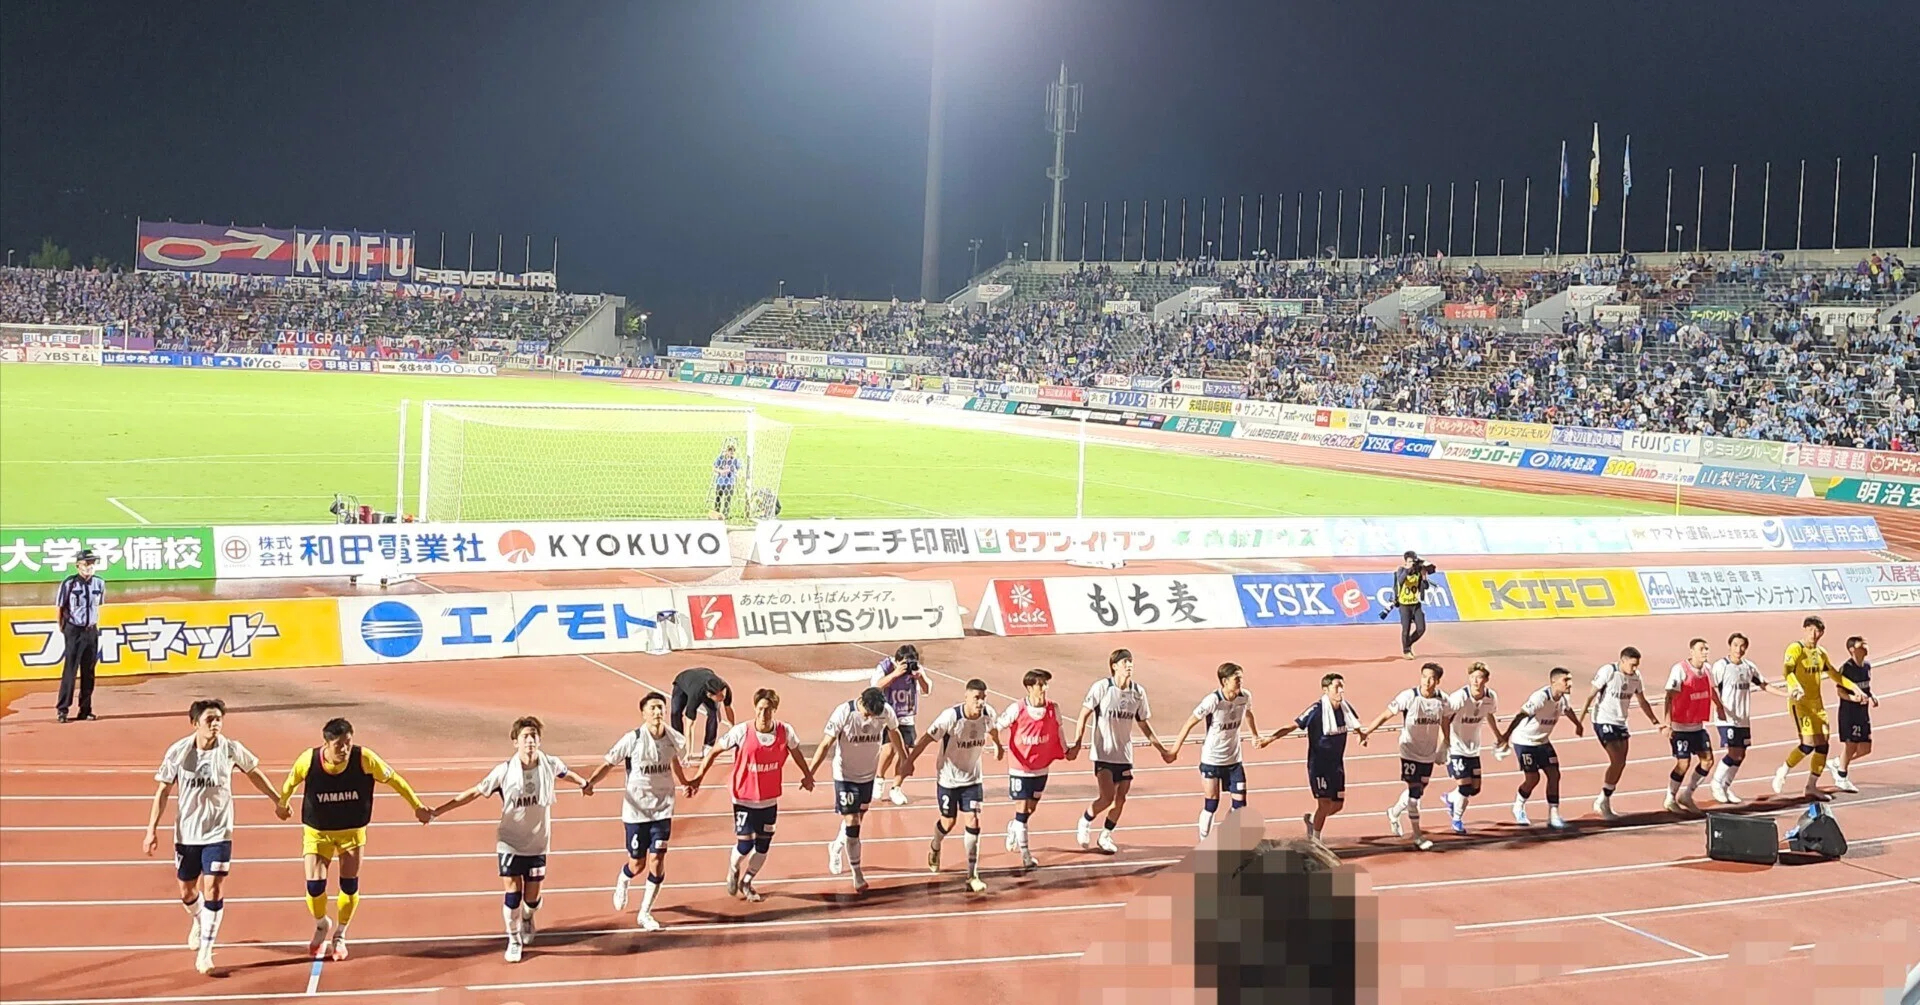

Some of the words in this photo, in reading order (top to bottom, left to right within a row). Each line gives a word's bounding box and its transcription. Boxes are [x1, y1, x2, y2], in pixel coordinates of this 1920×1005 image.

[296, 233, 411, 276] KOFU
[44, 352, 70, 361] YBS
[1160, 396, 1184, 409] オギノ
[1175, 417, 1222, 434] 明治安田
[1366, 436, 1391, 451] YSK
[1631, 435, 1691, 452] FUJISEY
[1715, 443, 1783, 461] ミヨシグループ
[1549, 454, 1598, 472] 清水建設
[1700, 469, 1796, 492] 山梨学院大学
[793, 527, 970, 556] サンニチ印刷
[1788, 524, 1880, 543] 山梨信用金庫
[258, 536, 293, 550] 株式
[300, 533, 486, 566] 和田電業社
[549, 532, 721, 557] KYOKUYO
[1, 536, 203, 573] 大学予備校
[259, 551, 294, 566] 会社
[1687, 570, 1764, 583] 建物総合管理
[1876, 565, 1920, 583] 入居者
[739, 590, 896, 606] あなたの、いちばんメディア。
[1242, 582, 1334, 618] YSK
[1342, 586, 1451, 608] e-cm
[1483, 578, 1616, 610] KITO
[1651, 597, 1676, 606] group
[1675, 585, 1817, 608] 株式会社アポーメンテナンス
[1086, 580, 1207, 627] もち麦
[441, 603, 657, 645] エノモト
[742, 605, 944, 636] 山日YBSグループ
[747, 762, 778, 773] YAMAHA
[1522, 753, 1533, 765] 15
[1403, 762, 1416, 775] 29
[1316, 776, 1327, 790] 14
[317, 790, 359, 803] YAMAHA
[511, 796, 539, 808] YAMA
[839, 792, 854, 806] 30
[942, 795, 950, 810] 2
[631, 834, 639, 849] 6
